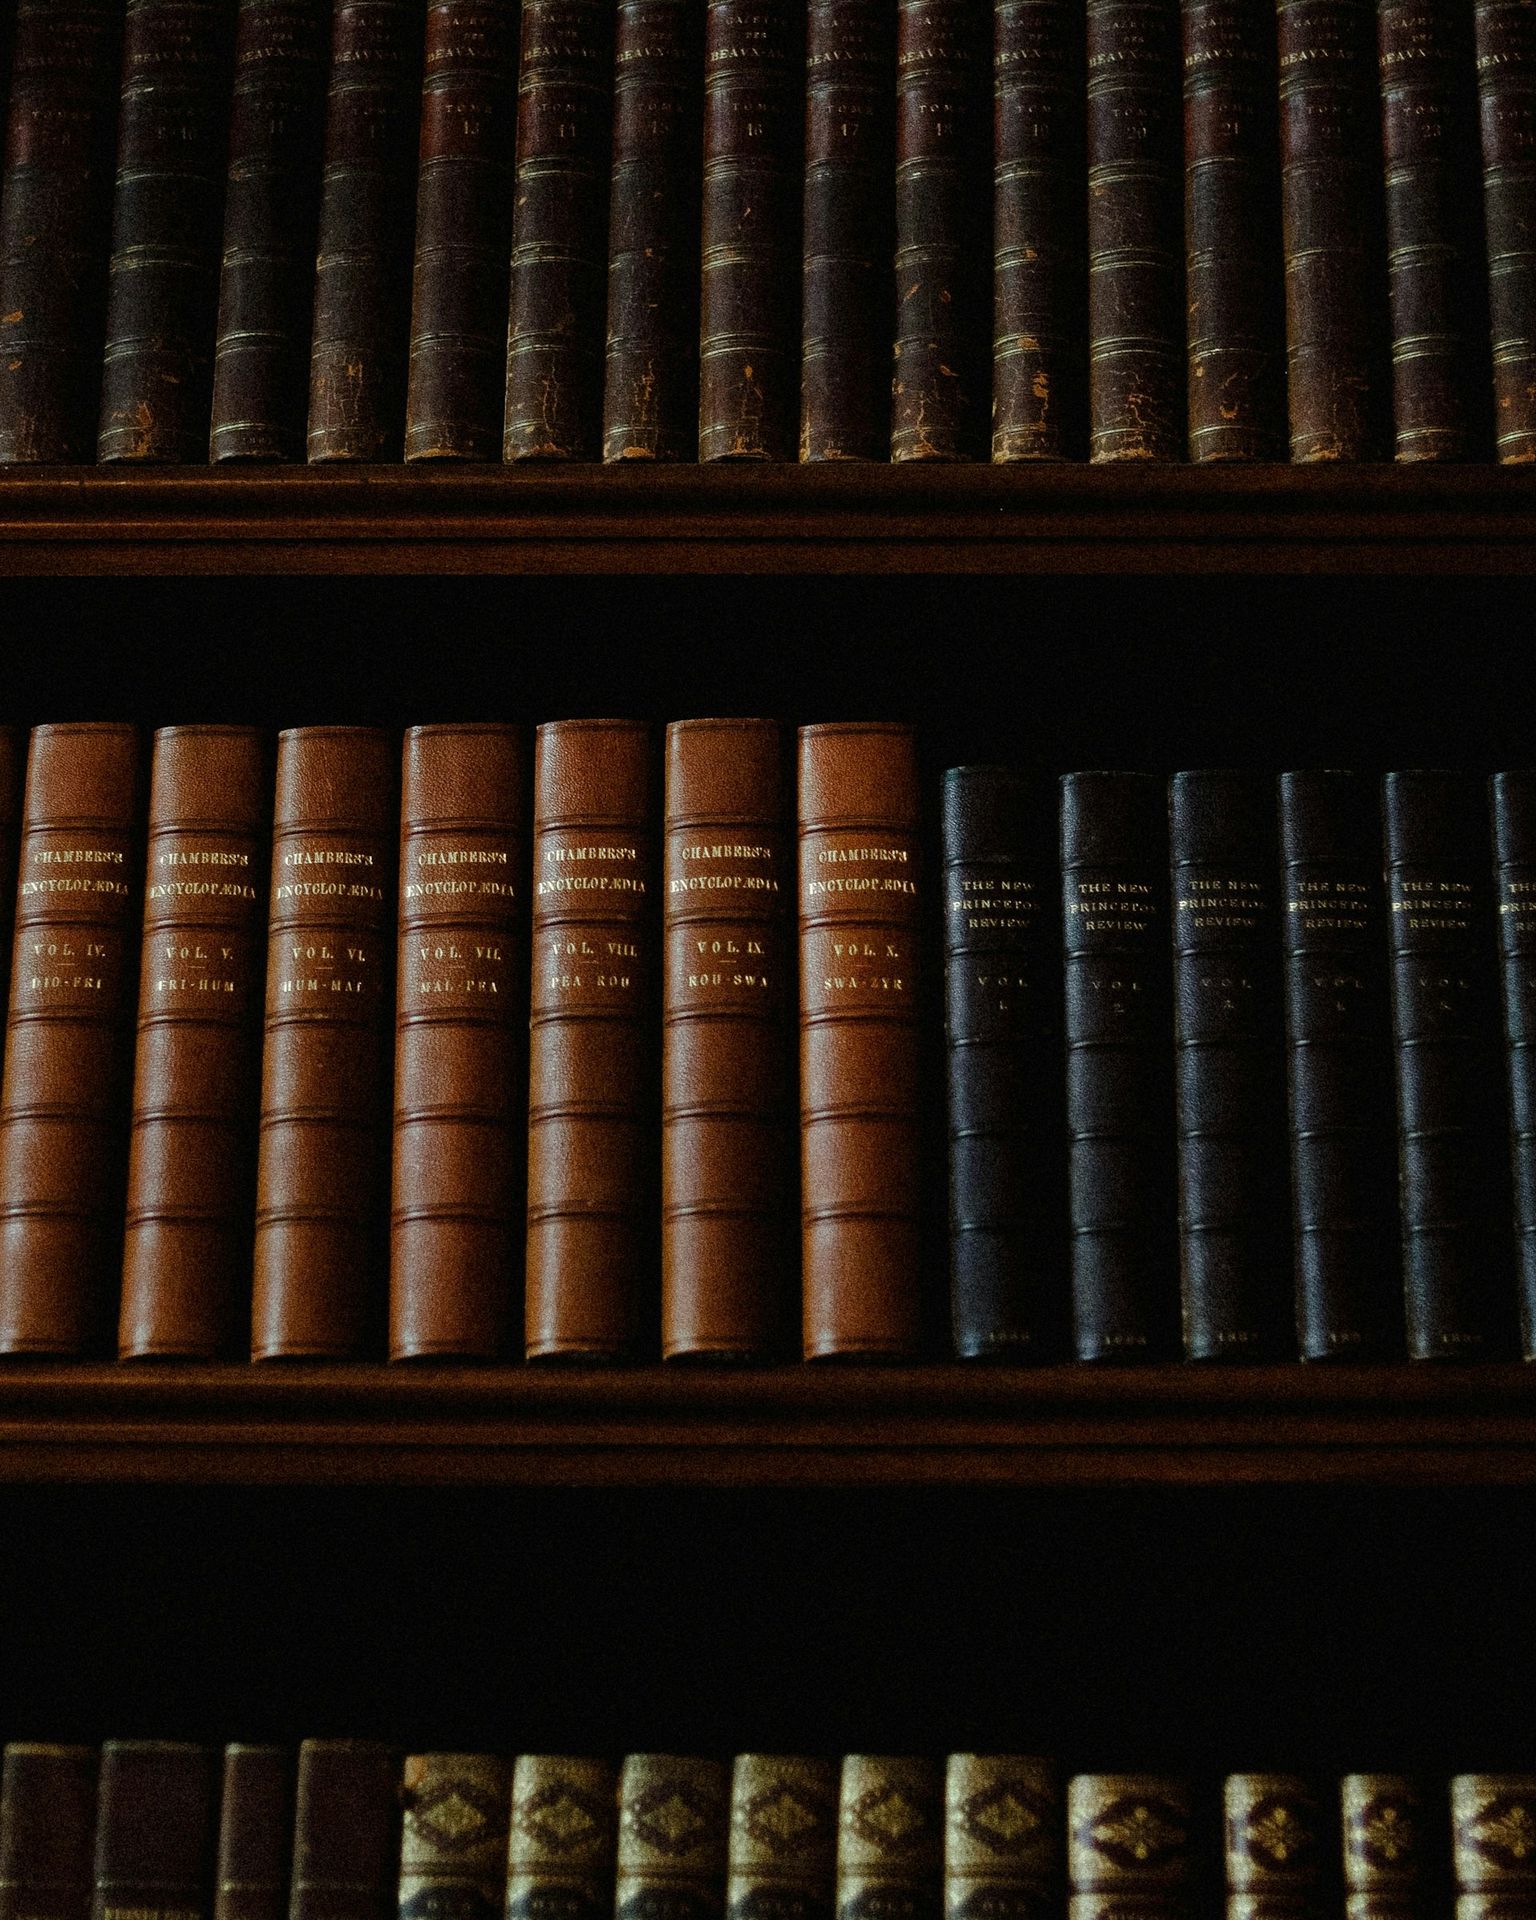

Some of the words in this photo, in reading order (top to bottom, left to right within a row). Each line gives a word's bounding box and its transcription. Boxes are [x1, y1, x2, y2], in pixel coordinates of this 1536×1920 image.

[34, 850, 123, 864] CHAMBERS'S
[547, 846, 636, 862] CHAMBERS'S
[682, 845, 771, 860] CHAMBERS'S
[818, 847, 908, 863] CHAMBERS'S
[159, 852, 249, 867] CHAMBERS'S
[284, 851, 374, 867] CHAMBERS'S
[417, 851, 507, 867] CHAMBERS'S
[962, 881, 994, 891] THE
[1078, 883, 1110, 894] THE
[1189, 880, 1221, 891] THE
[1298, 882, 1330, 893] THE
[1401, 882, 1433, 892] THE
[953, 900, 1040, 912] PRINCETO
[1070, 902, 1157, 915] PRINCETO
[1179, 899, 1267, 911] PRINCETO
[1289, 900, 1375, 913] PRINCETO
[1392, 900, 1477, 912] PRINCETO
[969, 918, 1031, 929] REVIEW
[1085, 920, 1148, 931] REVIEW
[1194, 917, 1256, 928] REVIEW
[1305, 919, 1368, 929] REVIEW
[1410, 918, 1471, 929] REVIEW
